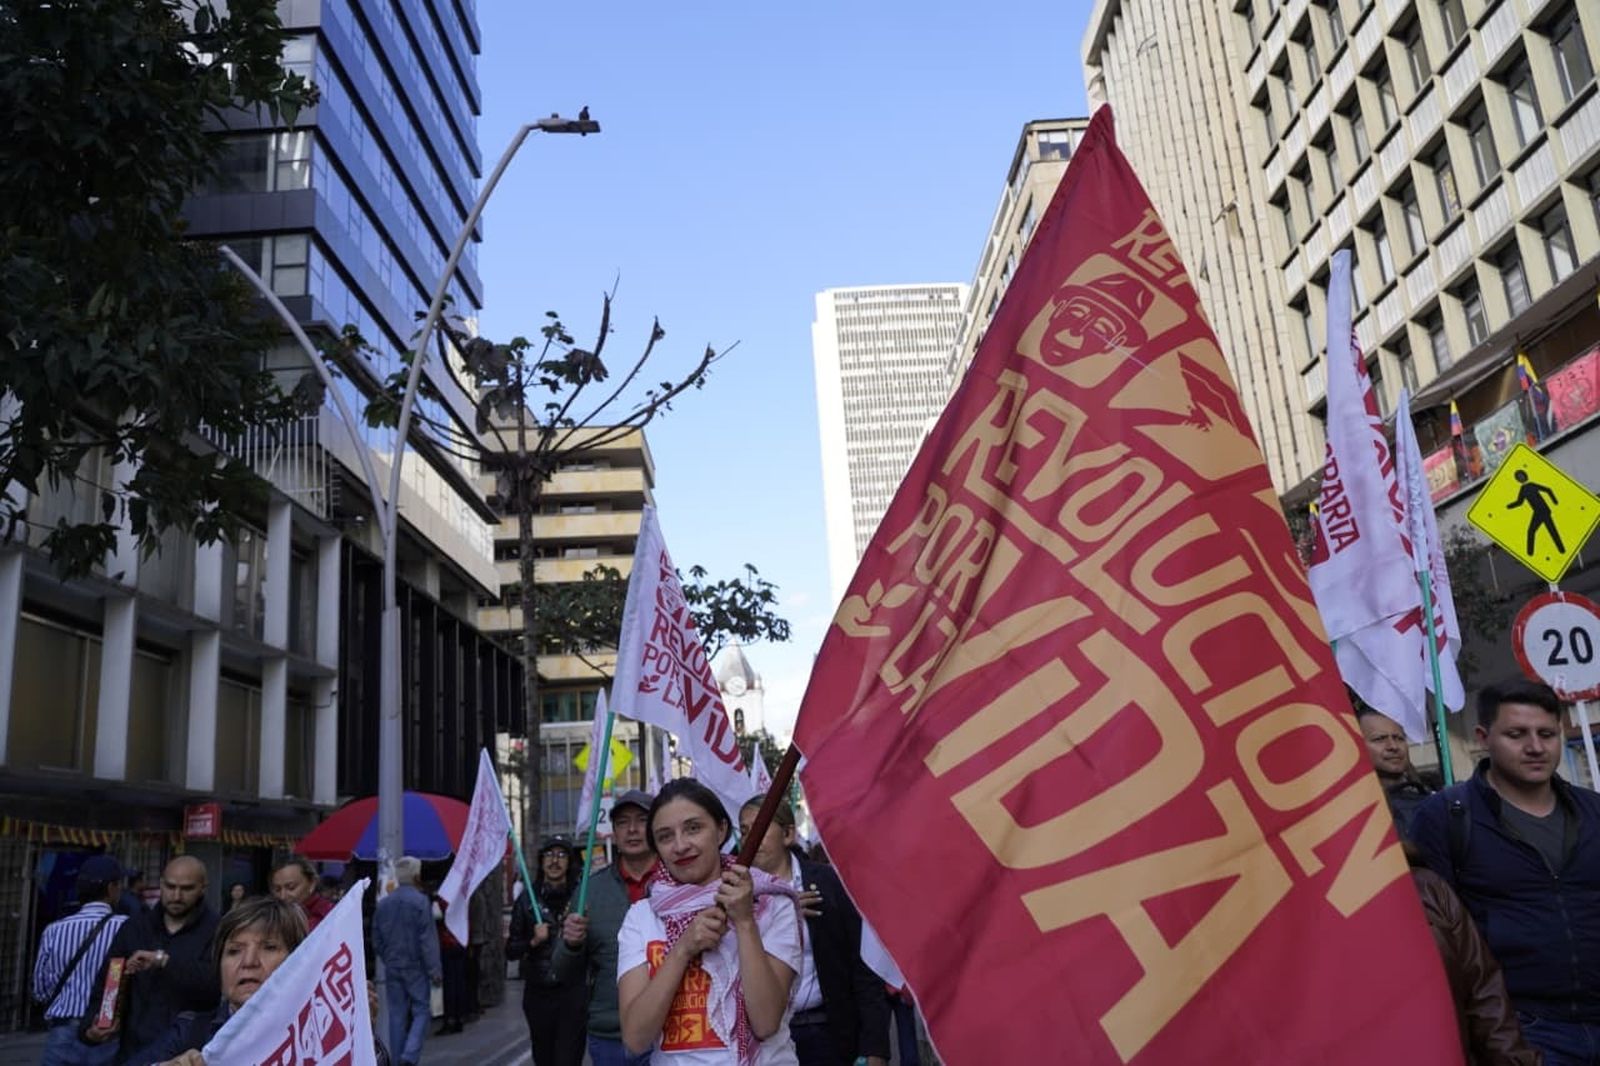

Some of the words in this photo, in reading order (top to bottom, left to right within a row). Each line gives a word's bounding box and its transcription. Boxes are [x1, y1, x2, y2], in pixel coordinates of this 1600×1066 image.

[887, 482, 996, 612] POR
[1542, 626, 1594, 666] 20
[904, 534, 1294, 1064] VIDA
